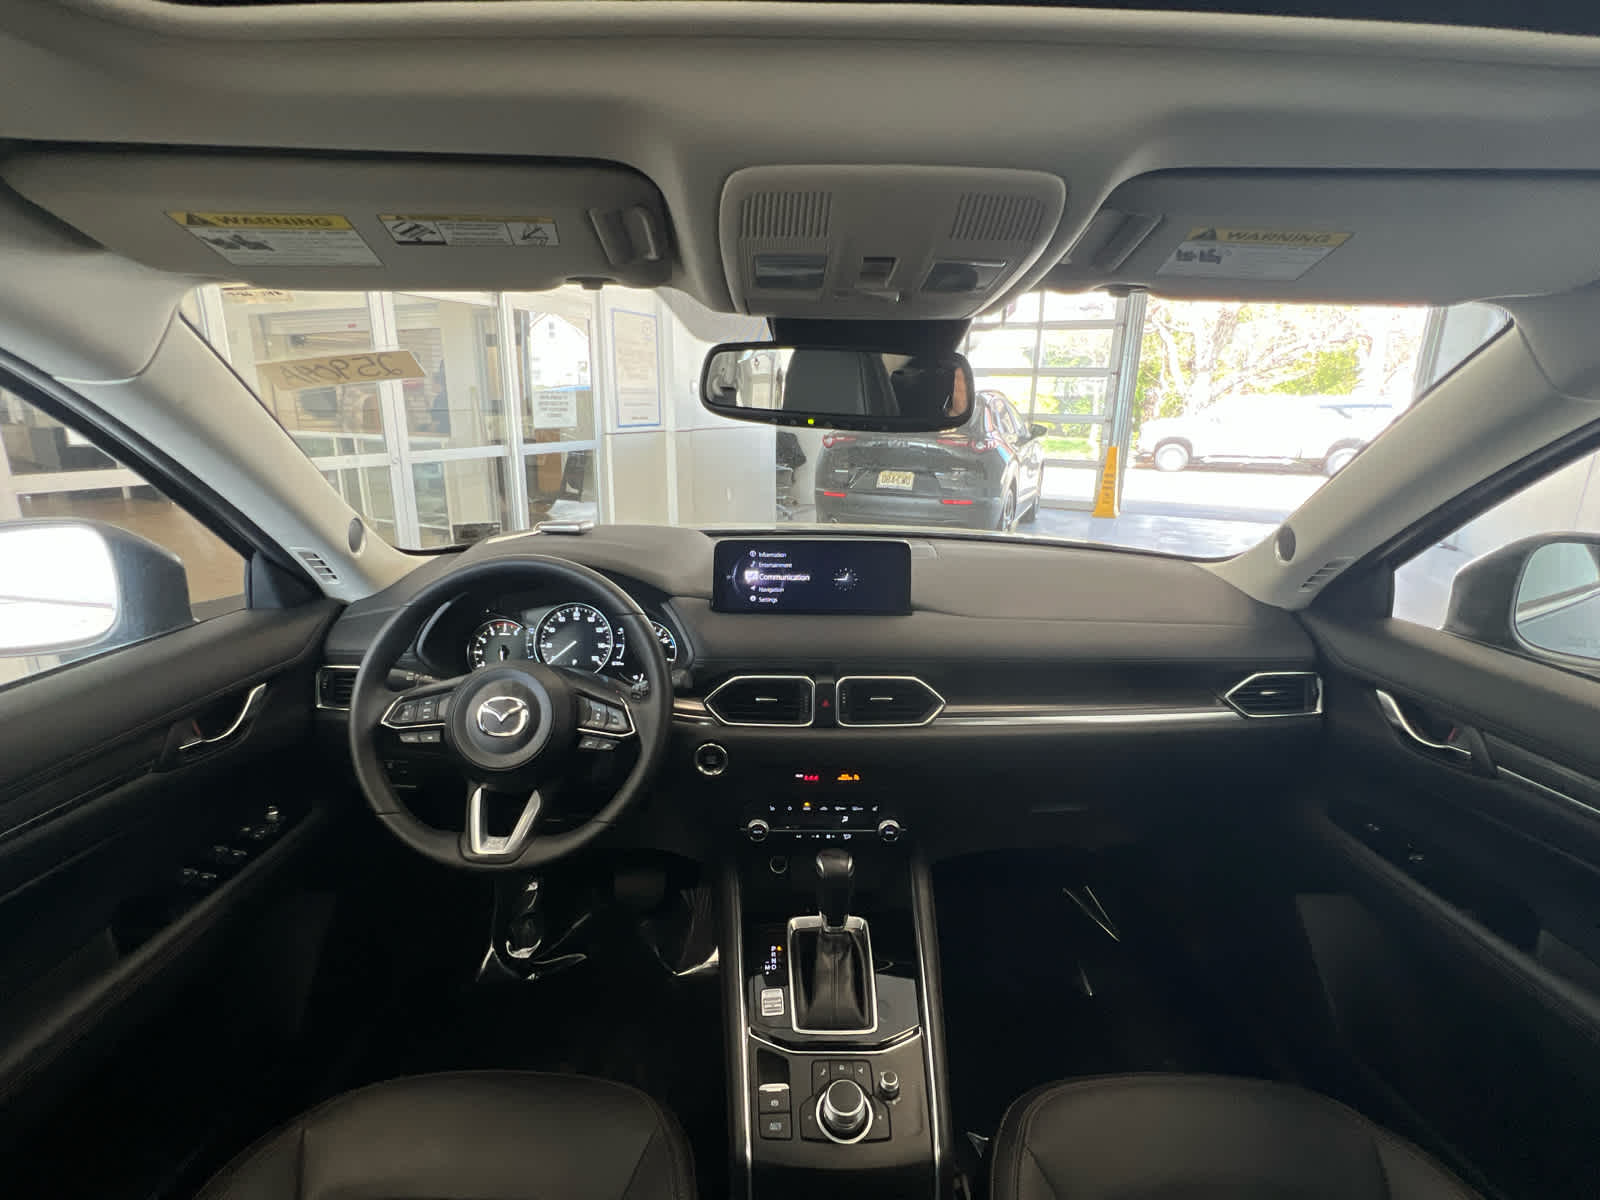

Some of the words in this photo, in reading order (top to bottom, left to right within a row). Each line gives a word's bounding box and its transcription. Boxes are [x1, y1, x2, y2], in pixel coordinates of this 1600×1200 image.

[214, 214, 333, 227] WARNING
[1226, 231, 1332, 243] WARNING
[758, 573, 811, 582] Communication
[758, 596, 778, 604] Settings
